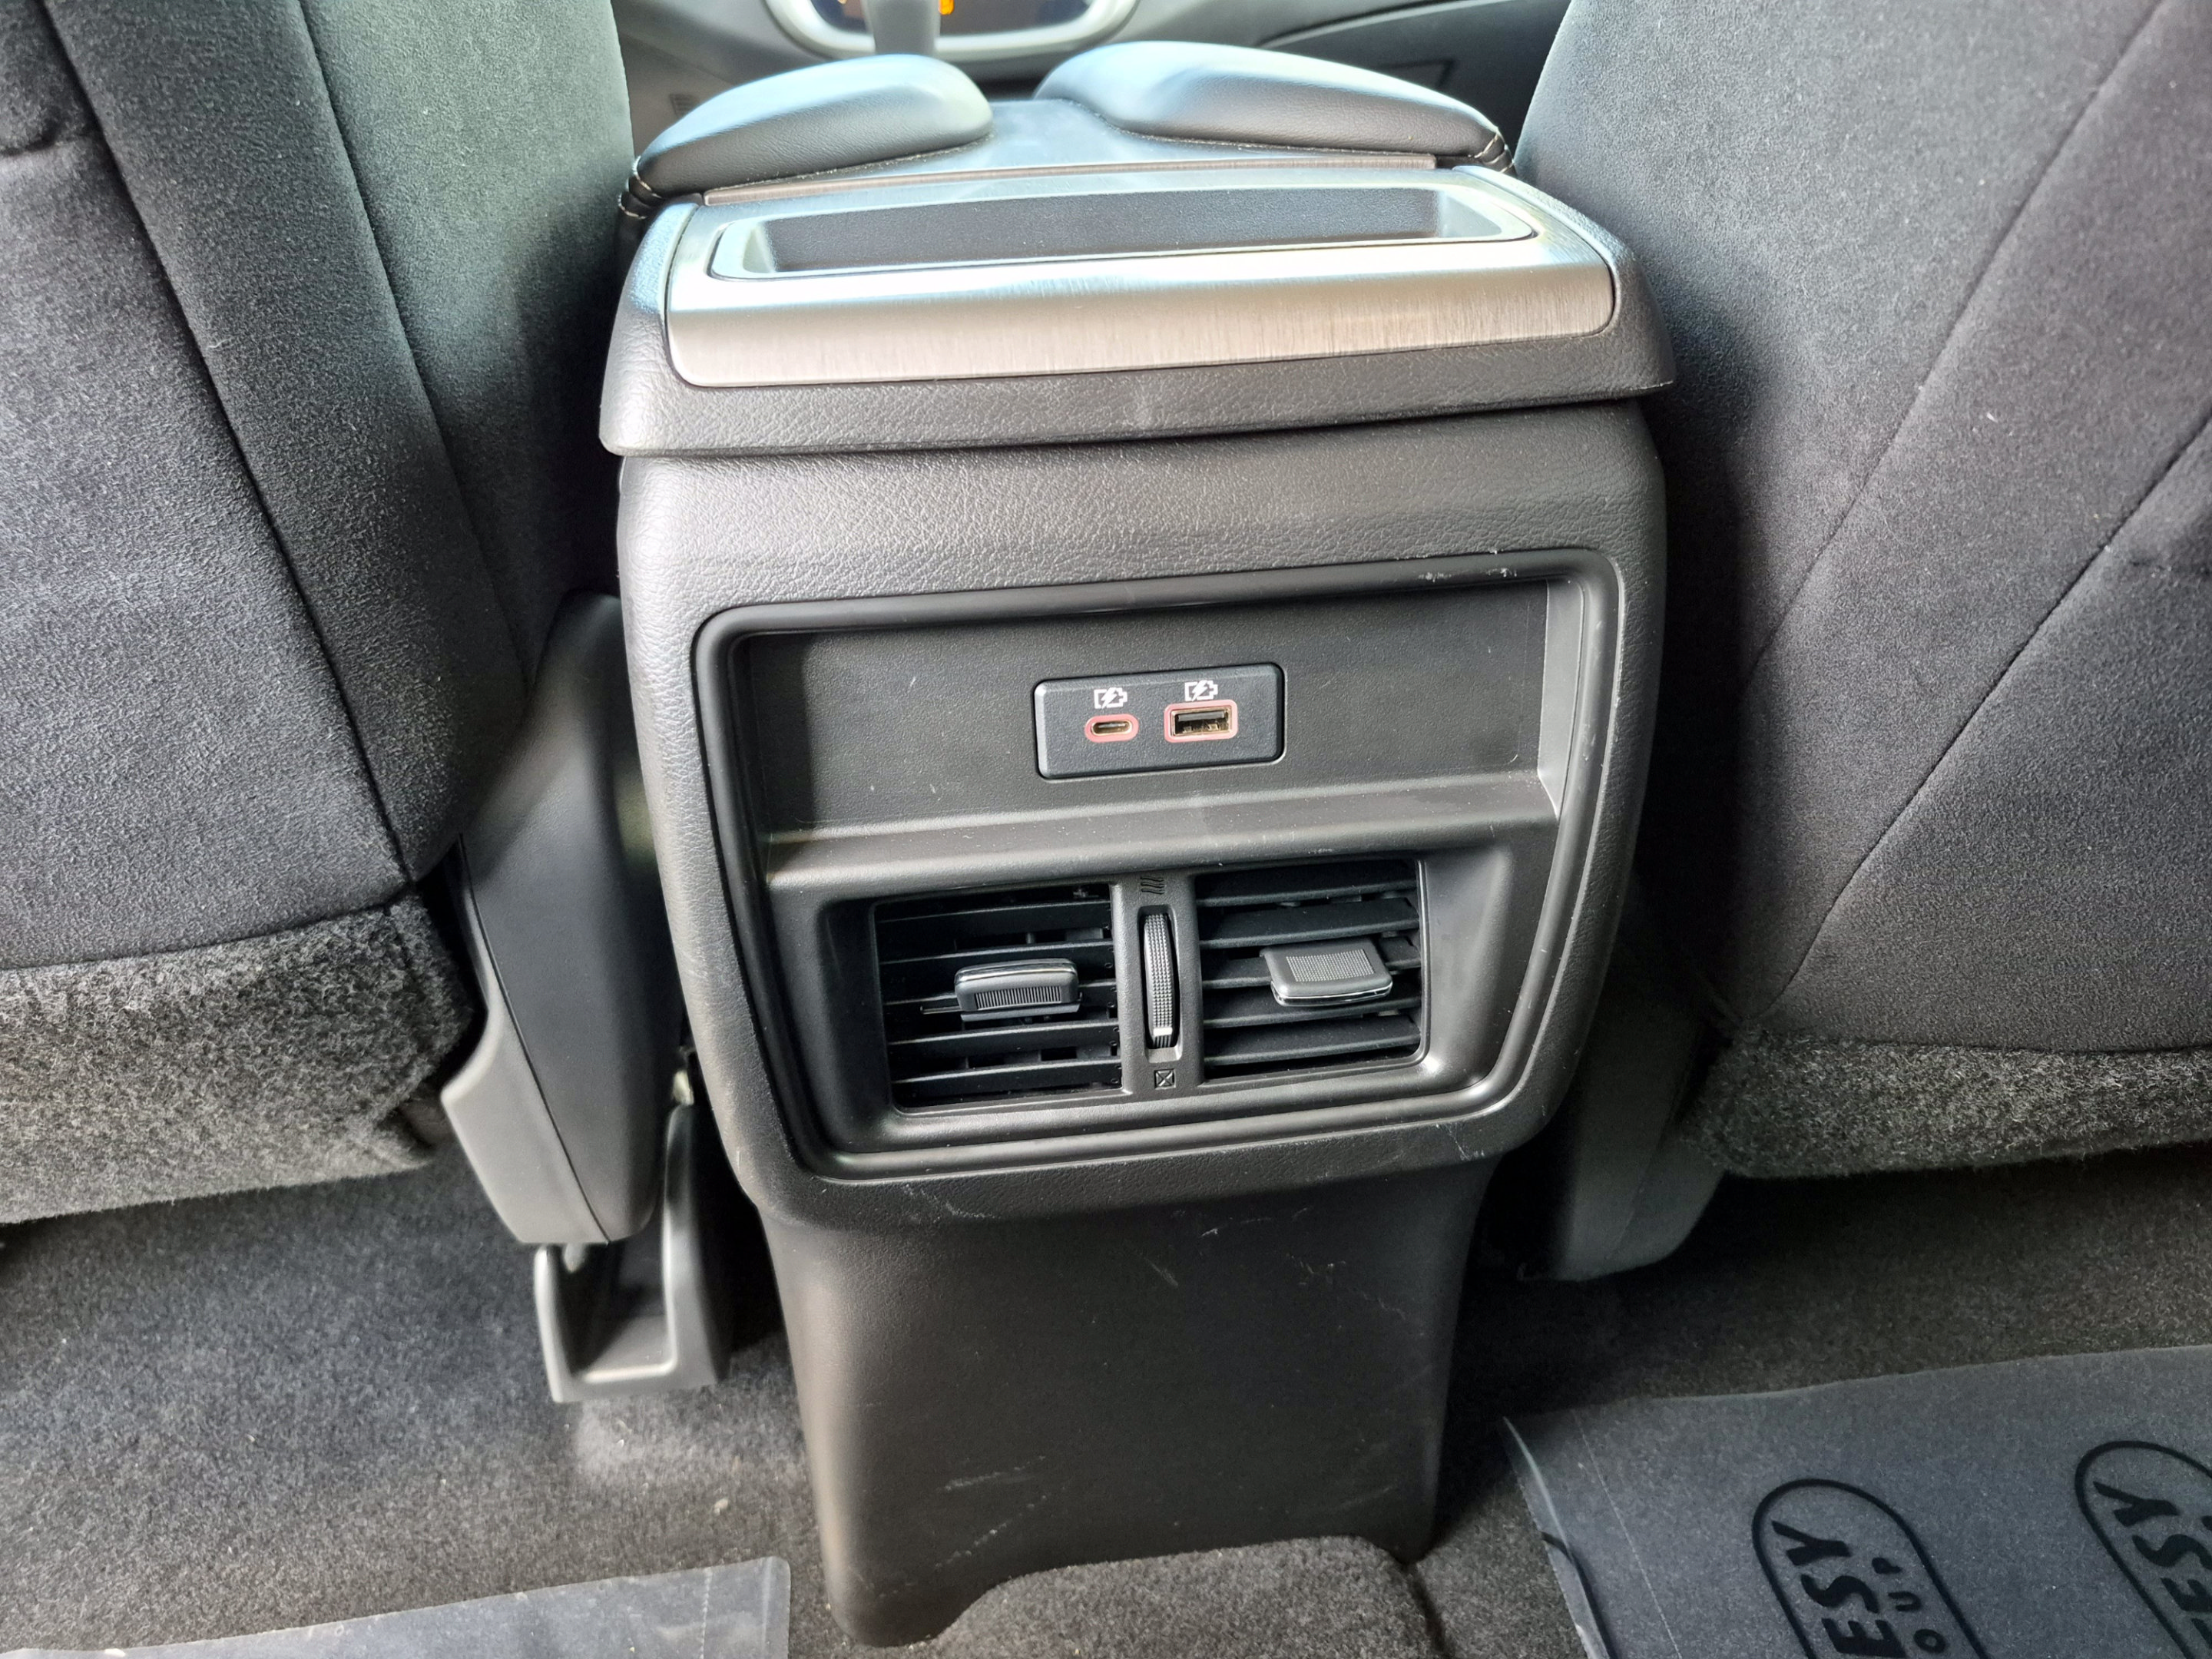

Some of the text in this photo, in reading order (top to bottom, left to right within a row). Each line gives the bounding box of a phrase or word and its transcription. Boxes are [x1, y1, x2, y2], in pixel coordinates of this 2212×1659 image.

[1771, 1520, 1906, 1658] ESY
[1872, 1557, 1946, 1654] OUP
[2093, 1481, 2212, 1649] ESY
